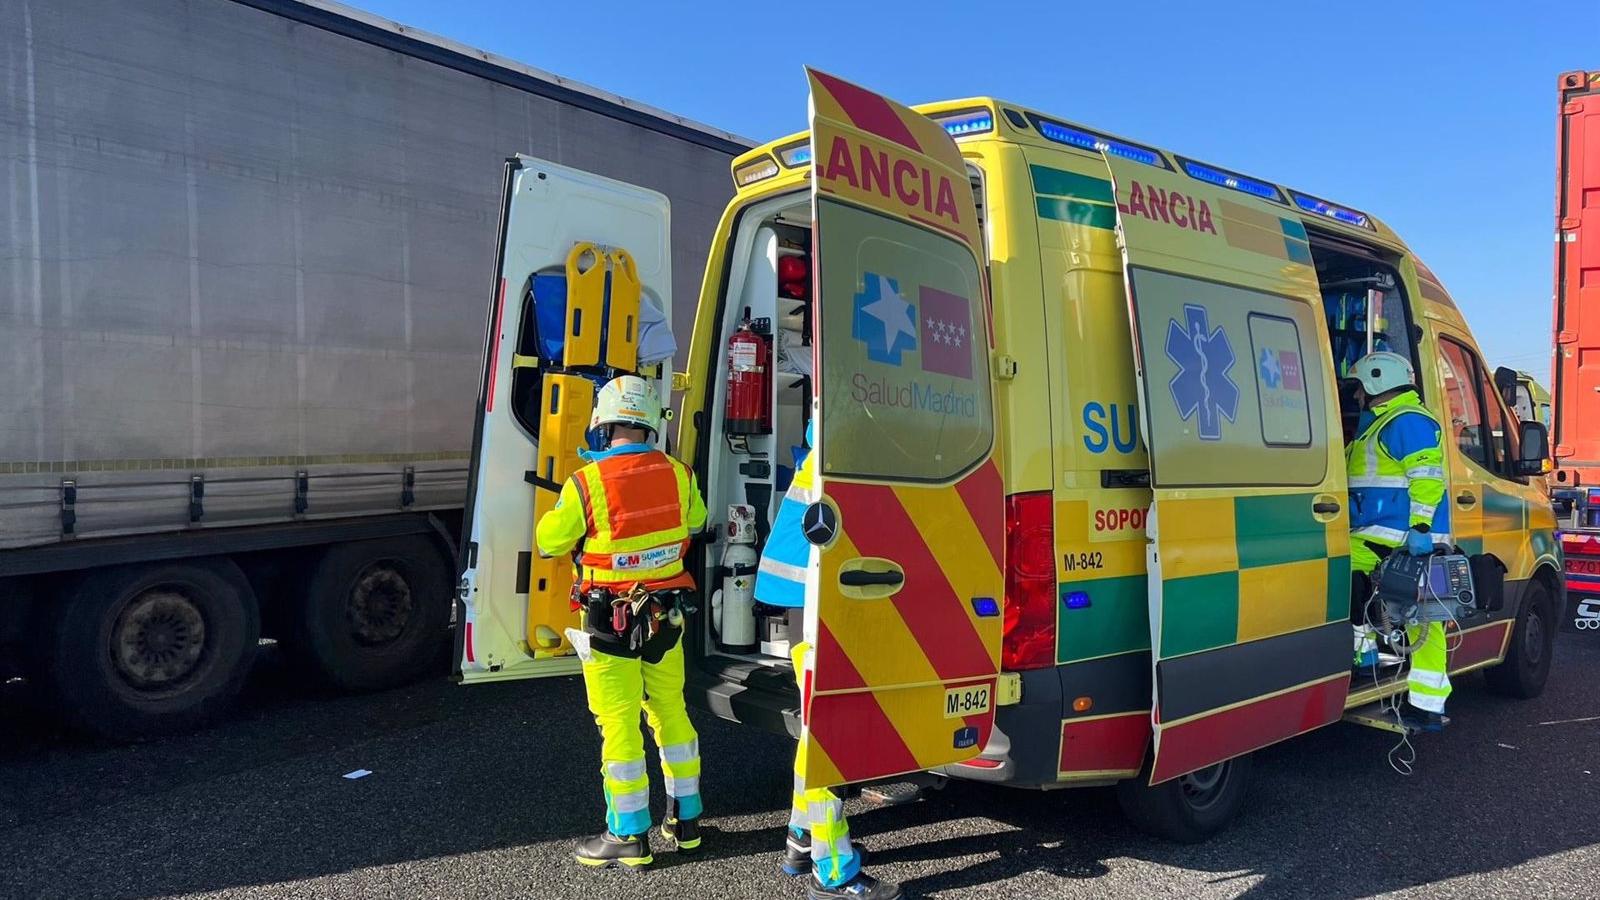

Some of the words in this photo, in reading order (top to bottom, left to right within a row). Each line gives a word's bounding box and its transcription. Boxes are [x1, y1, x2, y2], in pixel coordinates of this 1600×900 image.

[851, 373, 975, 418] SaludMadrid
[1083, 401, 1137, 454] SU
[1064, 552, 1103, 571] M-842
[947, 689, 987, 713] M-842
